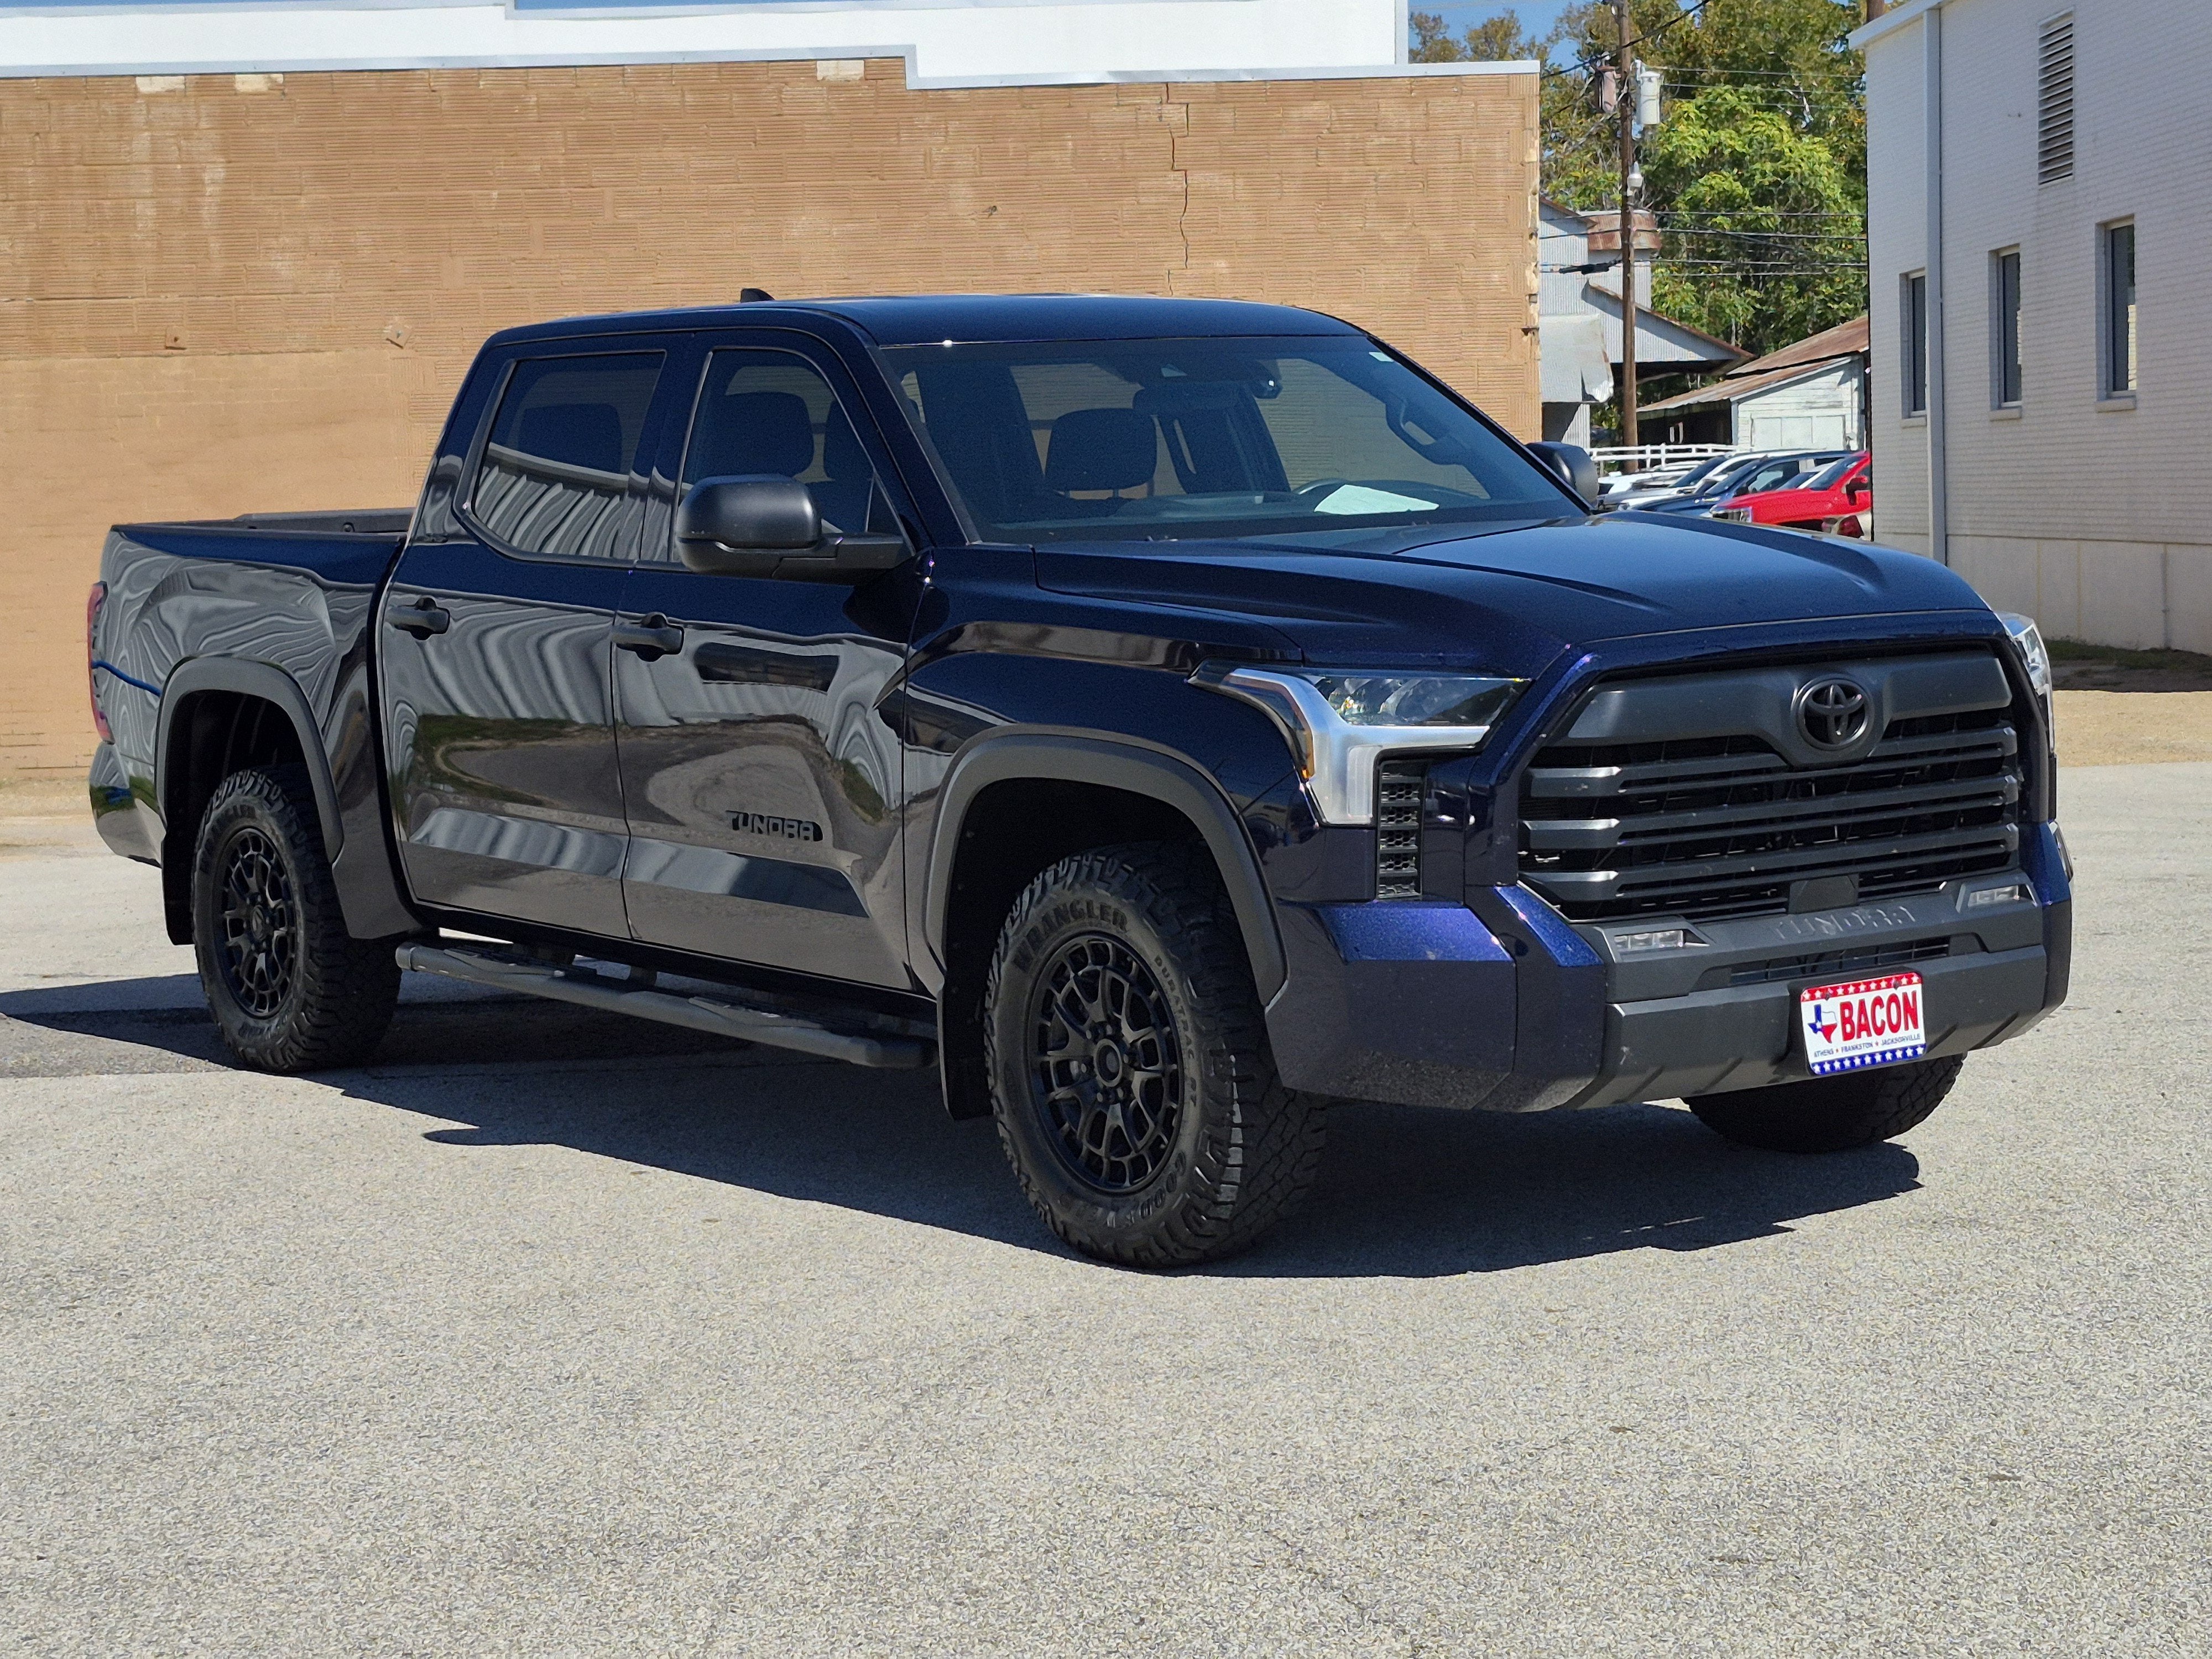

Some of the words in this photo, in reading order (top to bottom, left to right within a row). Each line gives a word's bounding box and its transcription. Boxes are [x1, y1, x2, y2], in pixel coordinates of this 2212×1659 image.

[725, 810, 817, 842] TUNDRA
[1013, 899, 1128, 973] WRANGLER
[1839, 990, 1919, 1041] BACON
